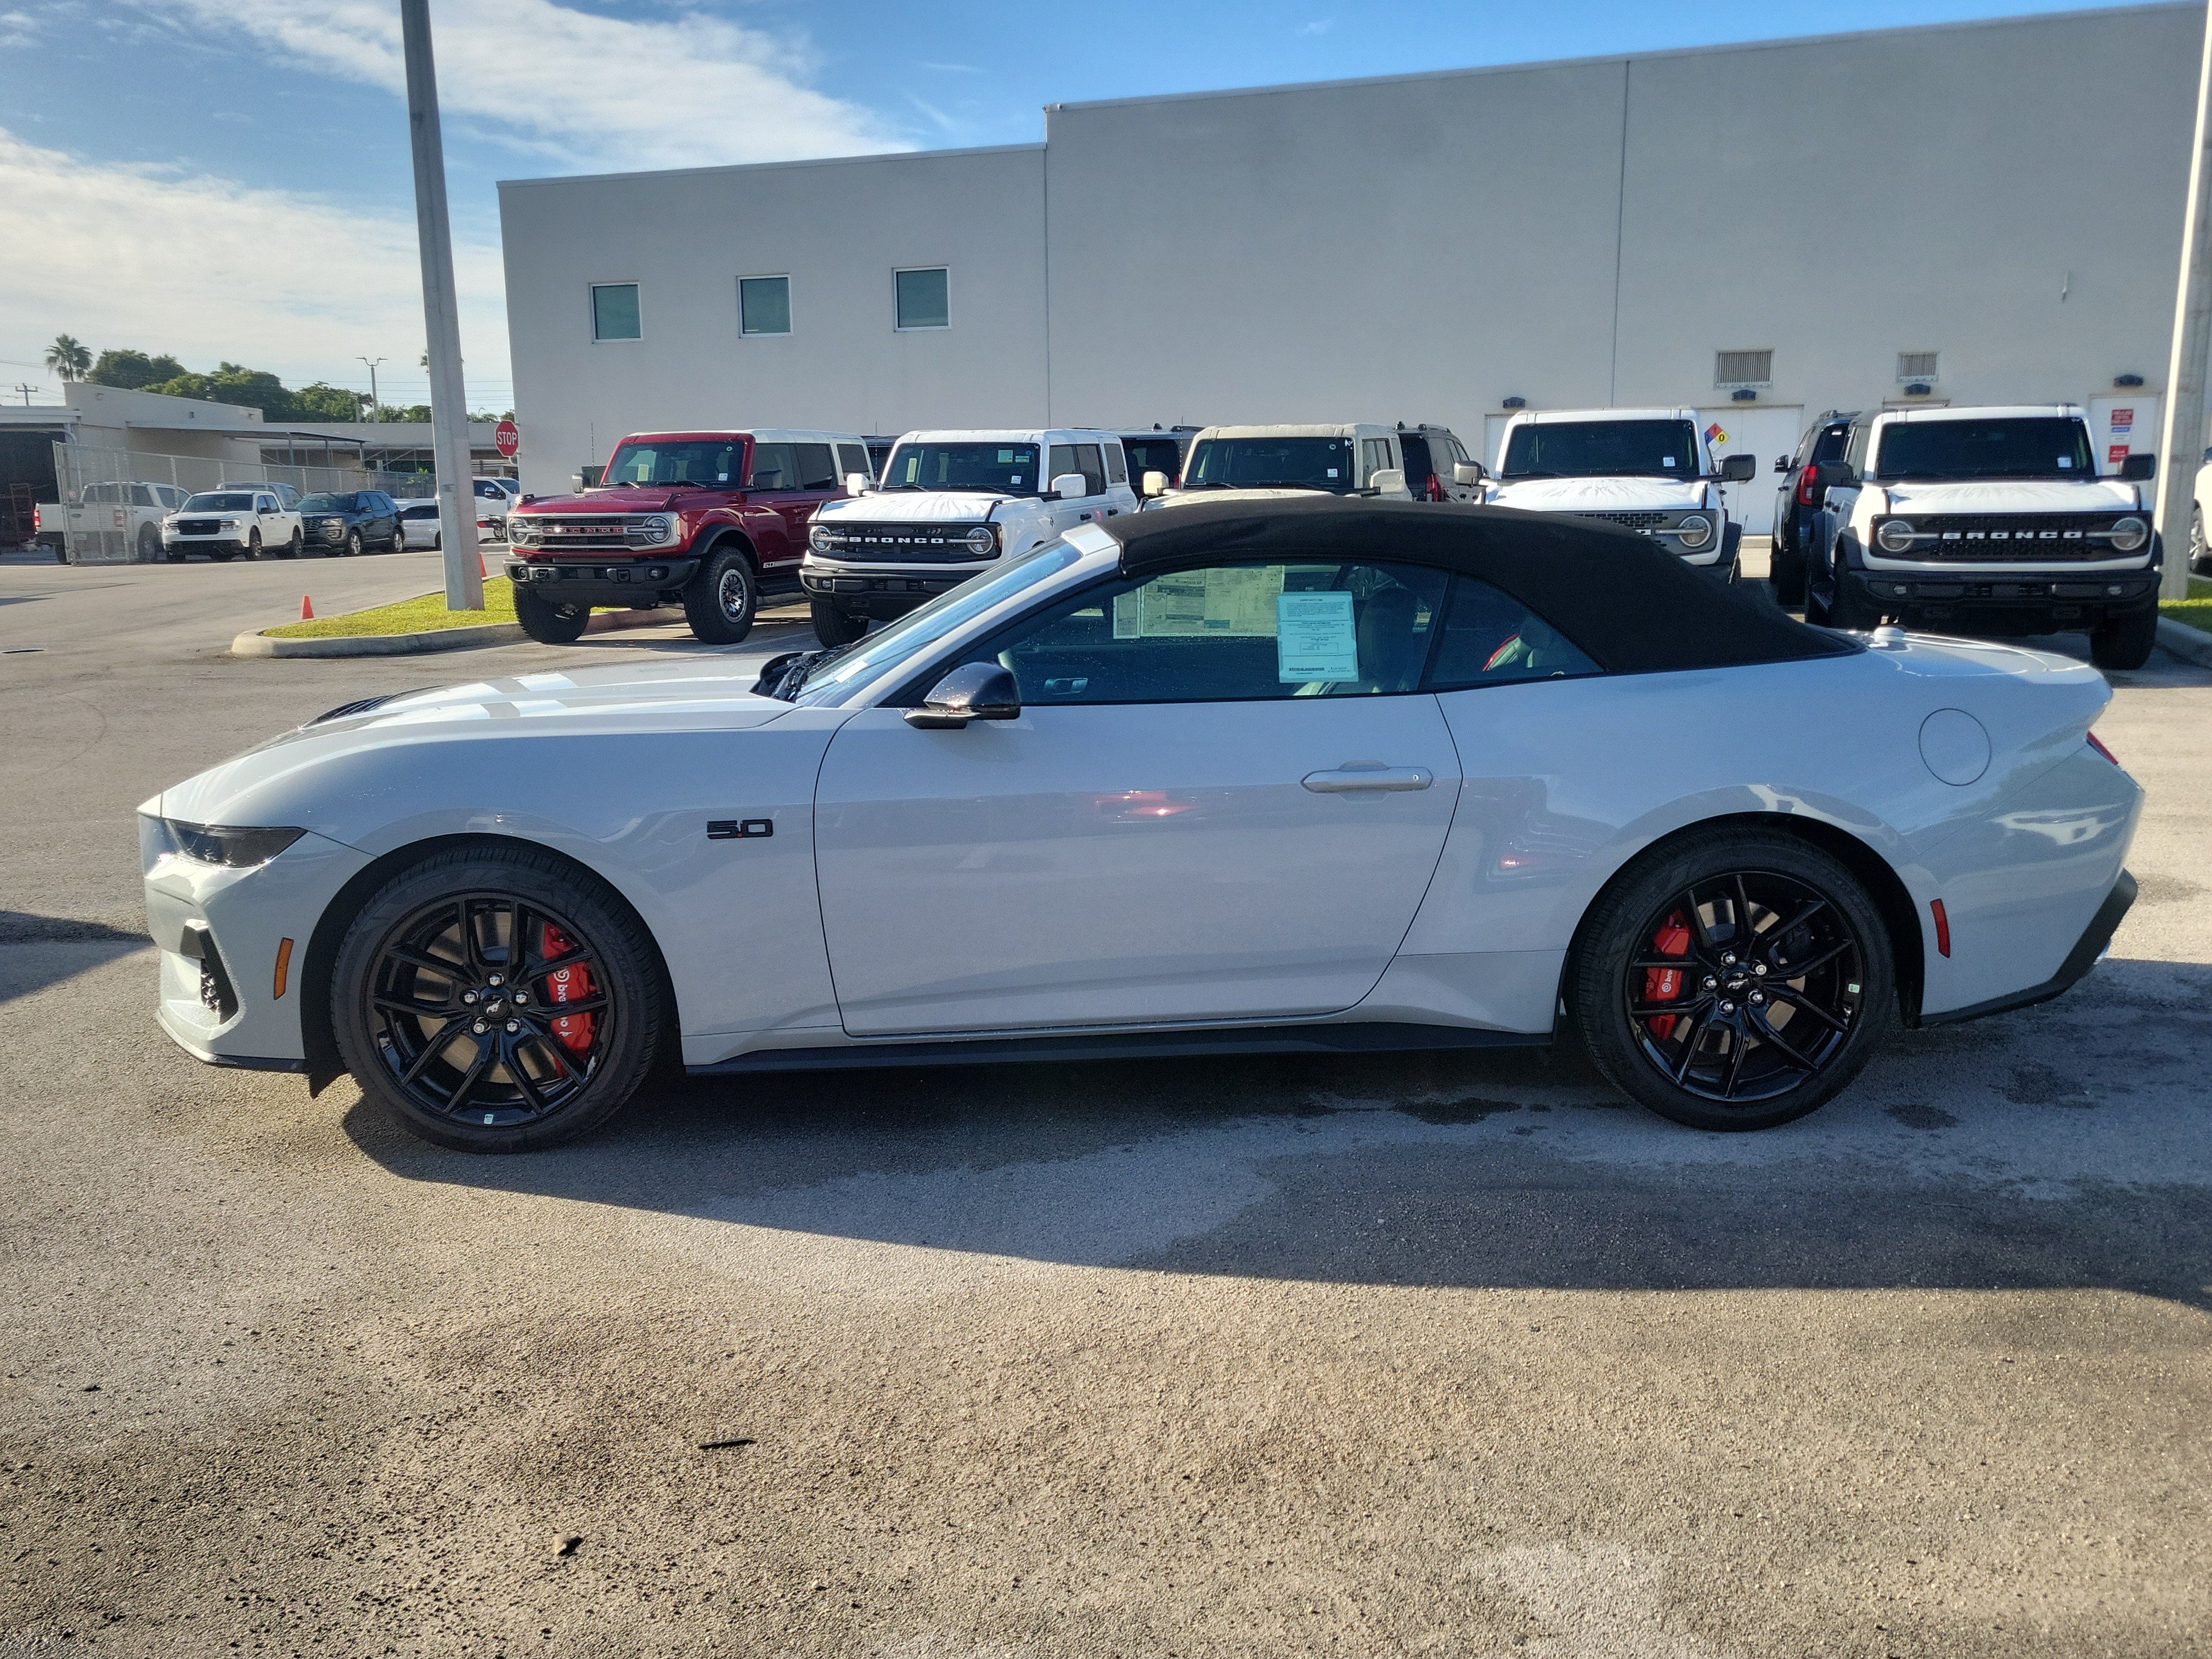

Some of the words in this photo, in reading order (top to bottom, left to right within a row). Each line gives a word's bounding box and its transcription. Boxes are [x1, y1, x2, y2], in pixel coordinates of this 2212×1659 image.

[497, 431, 517, 445] STOP
[1943, 531, 2083, 539] BRONCO
[707, 819, 774, 839] 5.0
[557, 984, 568, 1028] breo
